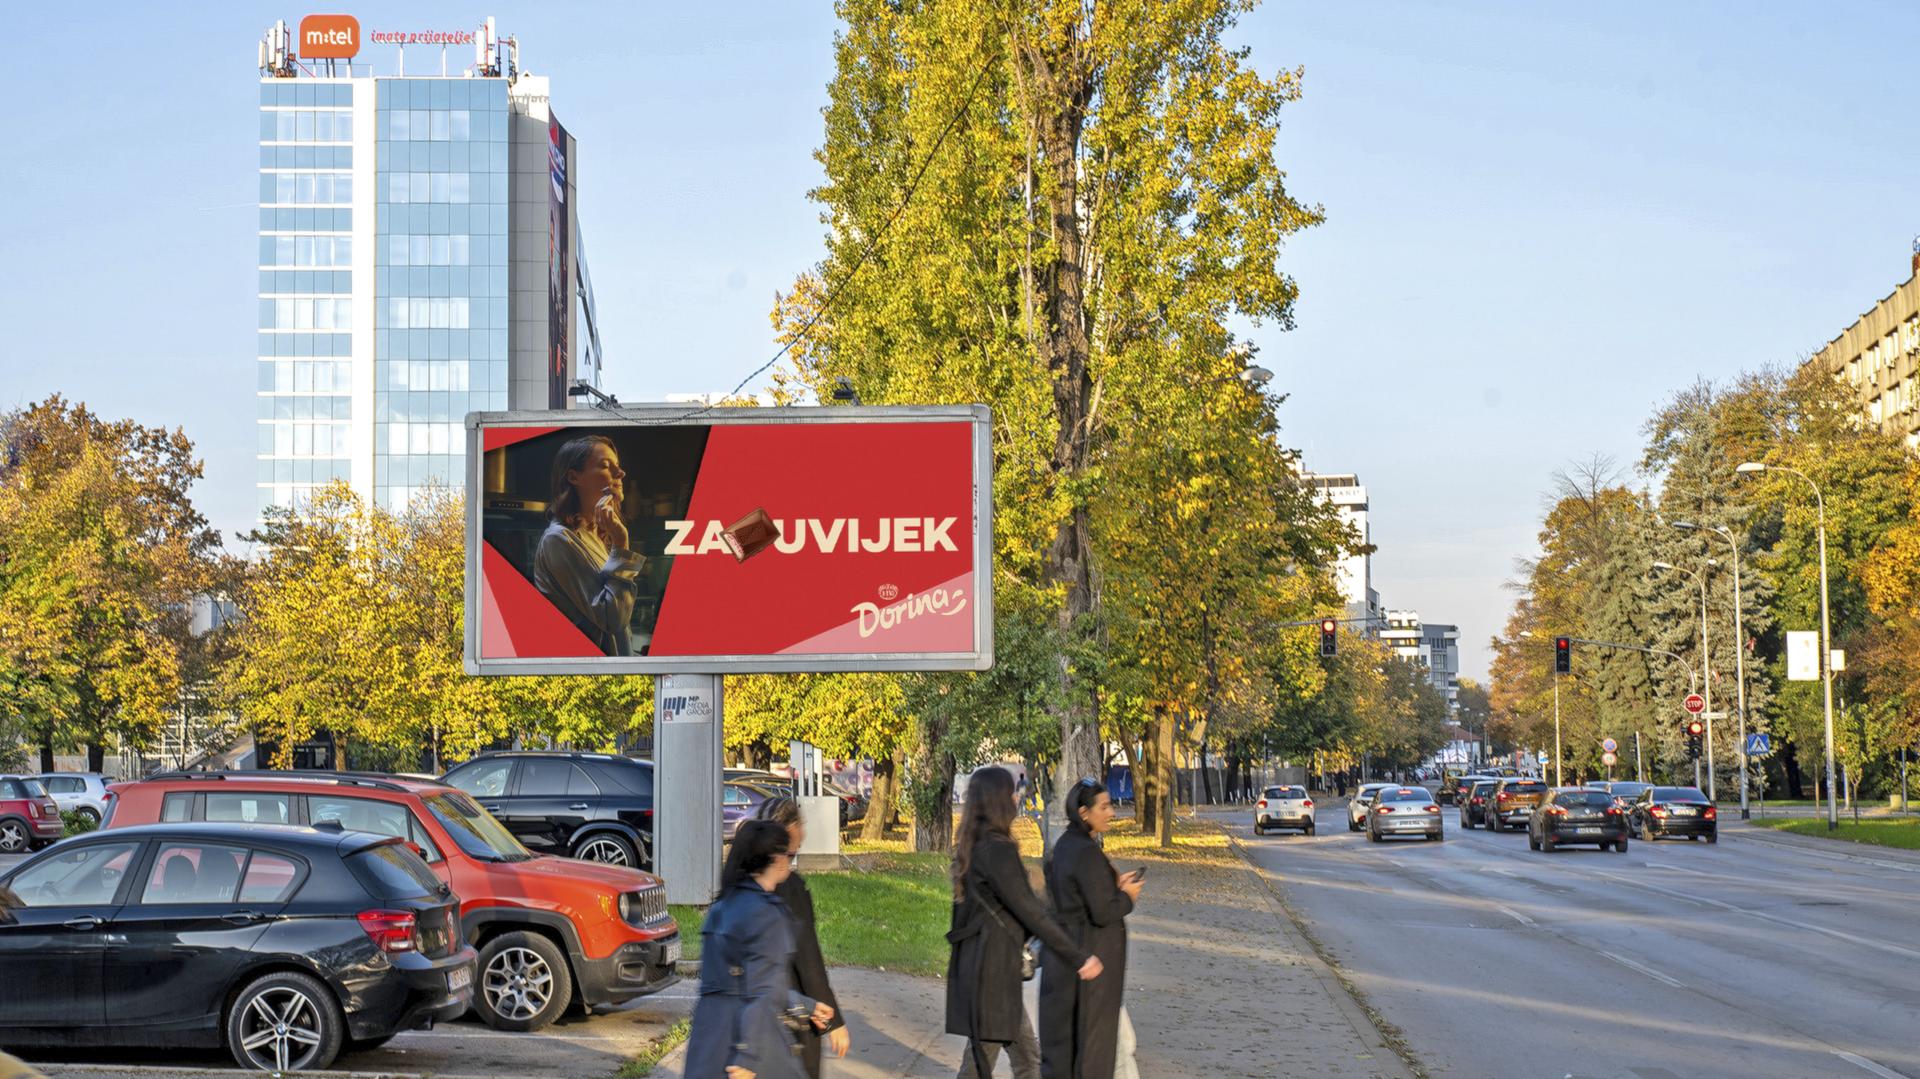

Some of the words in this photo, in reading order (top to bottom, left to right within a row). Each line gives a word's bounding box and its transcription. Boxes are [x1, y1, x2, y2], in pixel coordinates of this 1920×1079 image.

[307, 27, 353, 45] m:tel
[371, 30, 406, 43] imate
[850, 588, 949, 638] Dorina
[1686, 700, 1702, 708] STOP
[686, 708, 713, 716] GROUP
